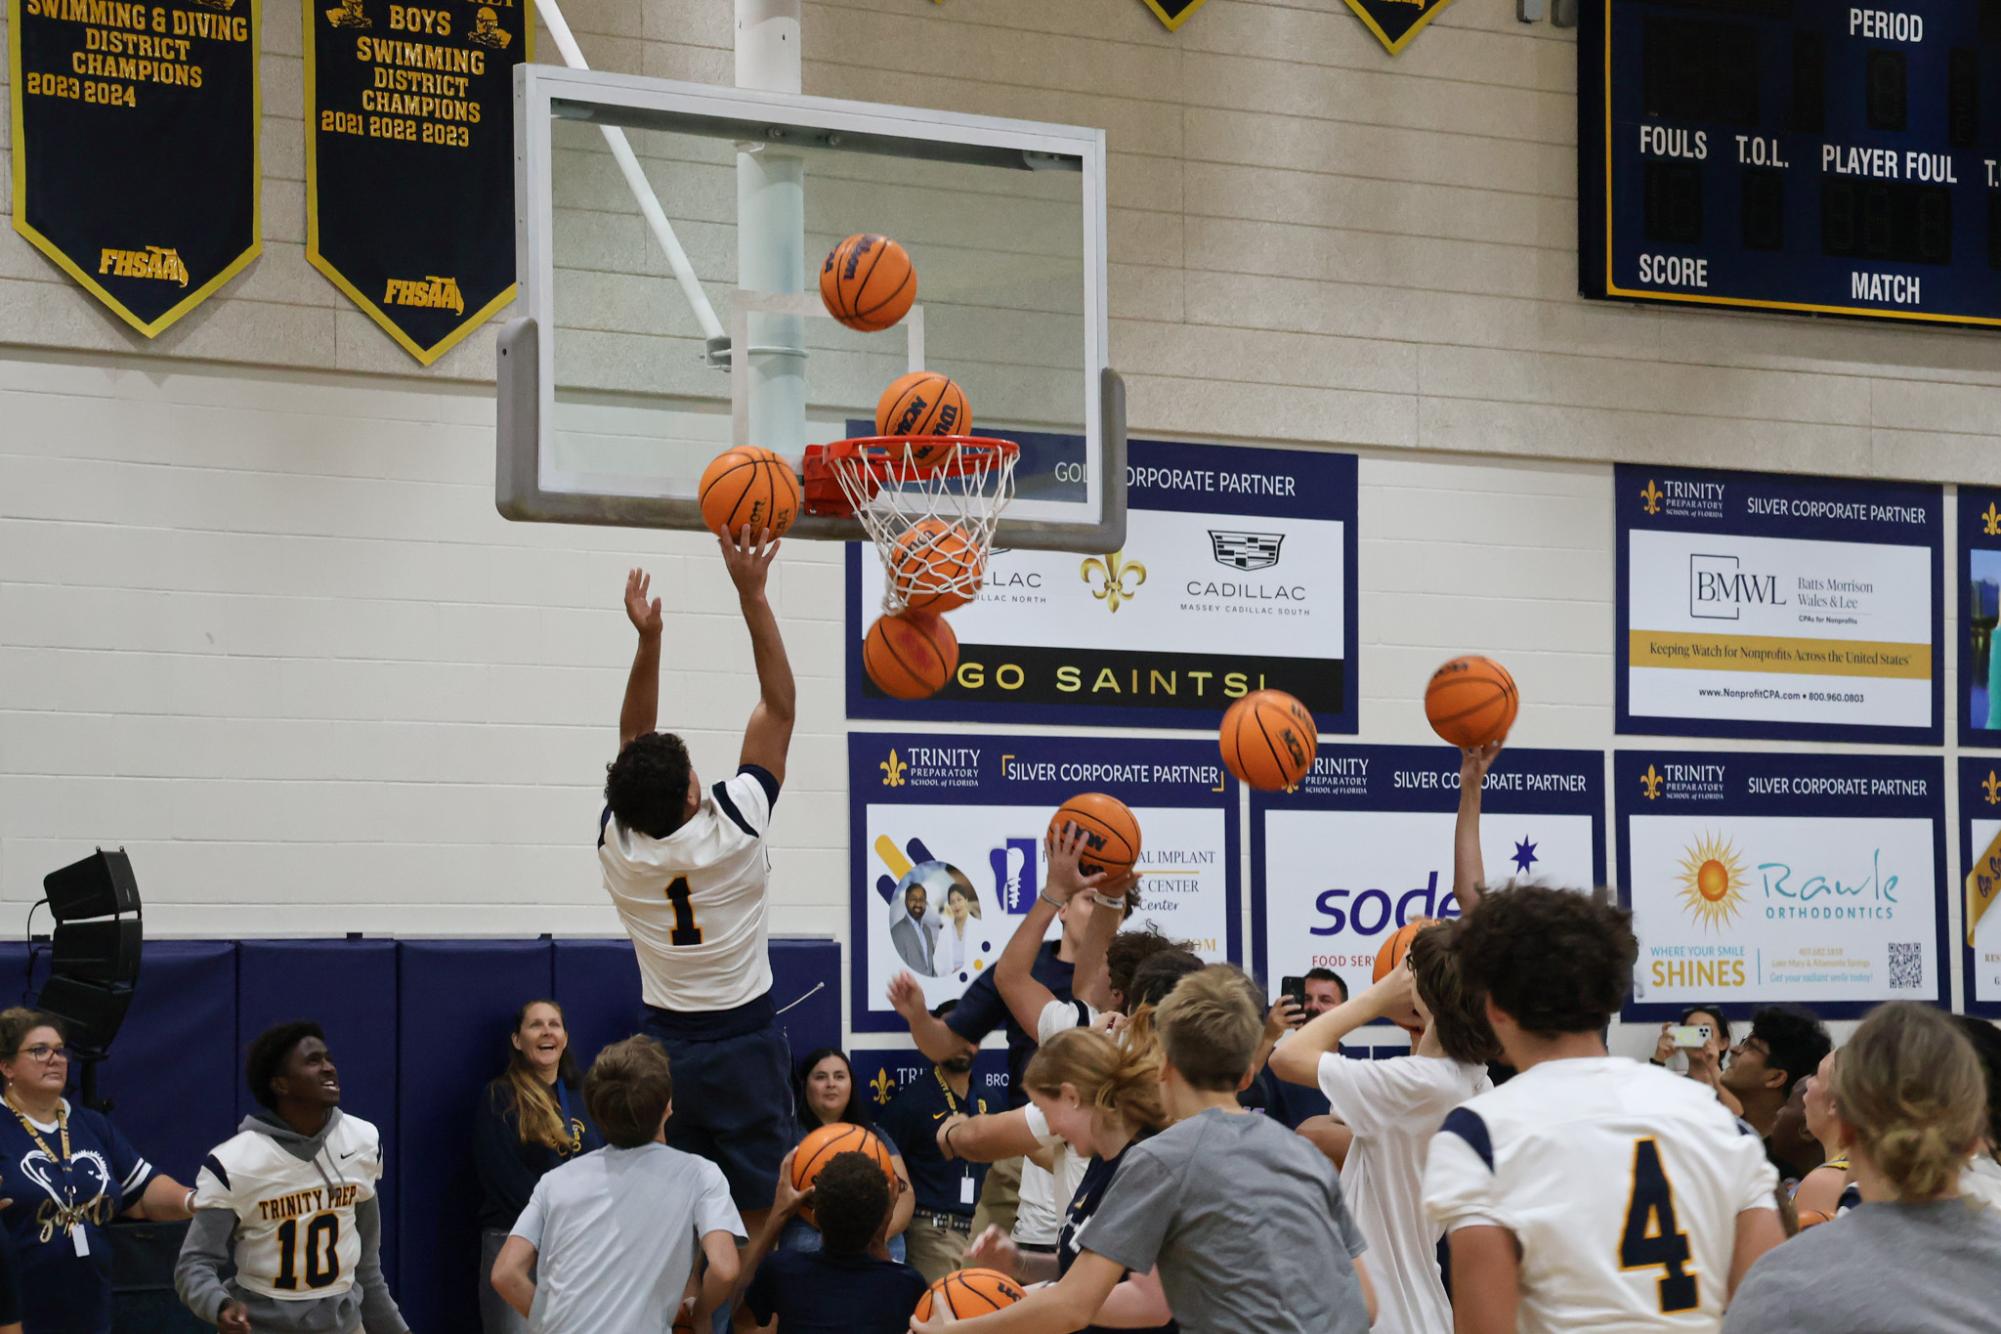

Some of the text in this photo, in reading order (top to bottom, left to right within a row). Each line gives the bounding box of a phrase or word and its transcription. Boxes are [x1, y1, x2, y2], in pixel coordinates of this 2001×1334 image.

[27, 0, 248, 42] SWIMMING & DIVING
[389, 5, 452, 36] BOYS
[1849, 7, 1923, 43] PERIOD
[86, 28, 190, 61] DISTRICT
[356, 36, 485, 76] SWIMMING
[72, 51, 203, 88] CHAMPIONS
[374, 66, 469, 98] DISTRICT
[27, 72, 136, 108] 2023 2024
[362, 90, 481, 124] CHAMPIONS
[321, 110, 470, 148] 2021 2022 2023
[1640, 125, 1708, 160] FOULS
[1736, 135, 1789, 168] T.O.L.
[1822, 144, 1958, 184] PLAYER FOUL
[99, 247, 184, 283] FHSAA
[1639, 254, 1708, 288] SCORE
[384, 277, 461, 311] FHSAA
[1851, 271, 1920, 305] MATCH
[1055, 462, 1296, 496] GOL ORPORATE PARTNER
[1664, 480, 1725, 500] TRINITY
[1666, 499, 1723, 509] PREPARATORY
[1666, 509, 1689, 517] SCHOOL
[1747, 497, 1926, 524] SILVER CORPORATE PARTNER
[1187, 581, 1306, 601] CADILLAC
[1697, 571, 1787, 606] BMWL
[1798, 577, 1873, 593] Batts Morrison
[1012, 596, 1046, 604] NORTH
[1180, 603, 1310, 616] MASSEY CADILLAC SOUTH
[1798, 593, 1828, 607] Wales
[1830, 595, 1838, 608] &
[1650, 642, 1689, 658] Keeping
[1691, 644, 1722, 657] Watch
[1724, 645, 1738, 658] for
[1740, 647, 1792, 662] Nonprofits
[1794, 647, 1826, 662] Across
[1828, 650, 1843, 663] the
[1846, 650, 1878, 665] United
[957, 662, 1025, 690] GO
[1699, 688, 1800, 701] www.NonprofitCPA.com
[908, 747, 981, 767] TRINITY
[911, 768, 978, 778] PREPARATORY
[911, 778, 978, 788] SCHOOL of FLORIDA
[1008, 762, 1219, 784] SILVER CORPORATE PARTNER
[1305, 776, 1368, 786] PREPARATORY
[1393, 771, 1438, 789] SILVER
[1526, 774, 1586, 792] PARTNER
[1664, 764, 1725, 782] TRINITY
[1666, 782, 1724, 791] PREPARATORY
[1748, 777, 1927, 796] SILVER CORPORATE PARTNER
[1305, 786, 1331, 794] SCHOOL
[1333, 787, 1339, 795] of
[1158, 851, 1216, 864] IMPLANT
[1148, 879, 1199, 893] CENTER
[1757, 848, 1899, 903] Rawle
[664, 870, 704, 946] 1
[1139, 898, 1180, 911] Center
[1765, 907, 1894, 920] ORTHODONTICS
[1312, 955, 1346, 967] FOOD
[1650, 945, 1744, 957] WHERE YOUR SMILE
[1651, 959, 1746, 987] SHINES
[259, 1189, 322, 1220] TRINITY
[1620, 1135, 1700, 1314] 4
[273, 1210, 340, 1291] 10
